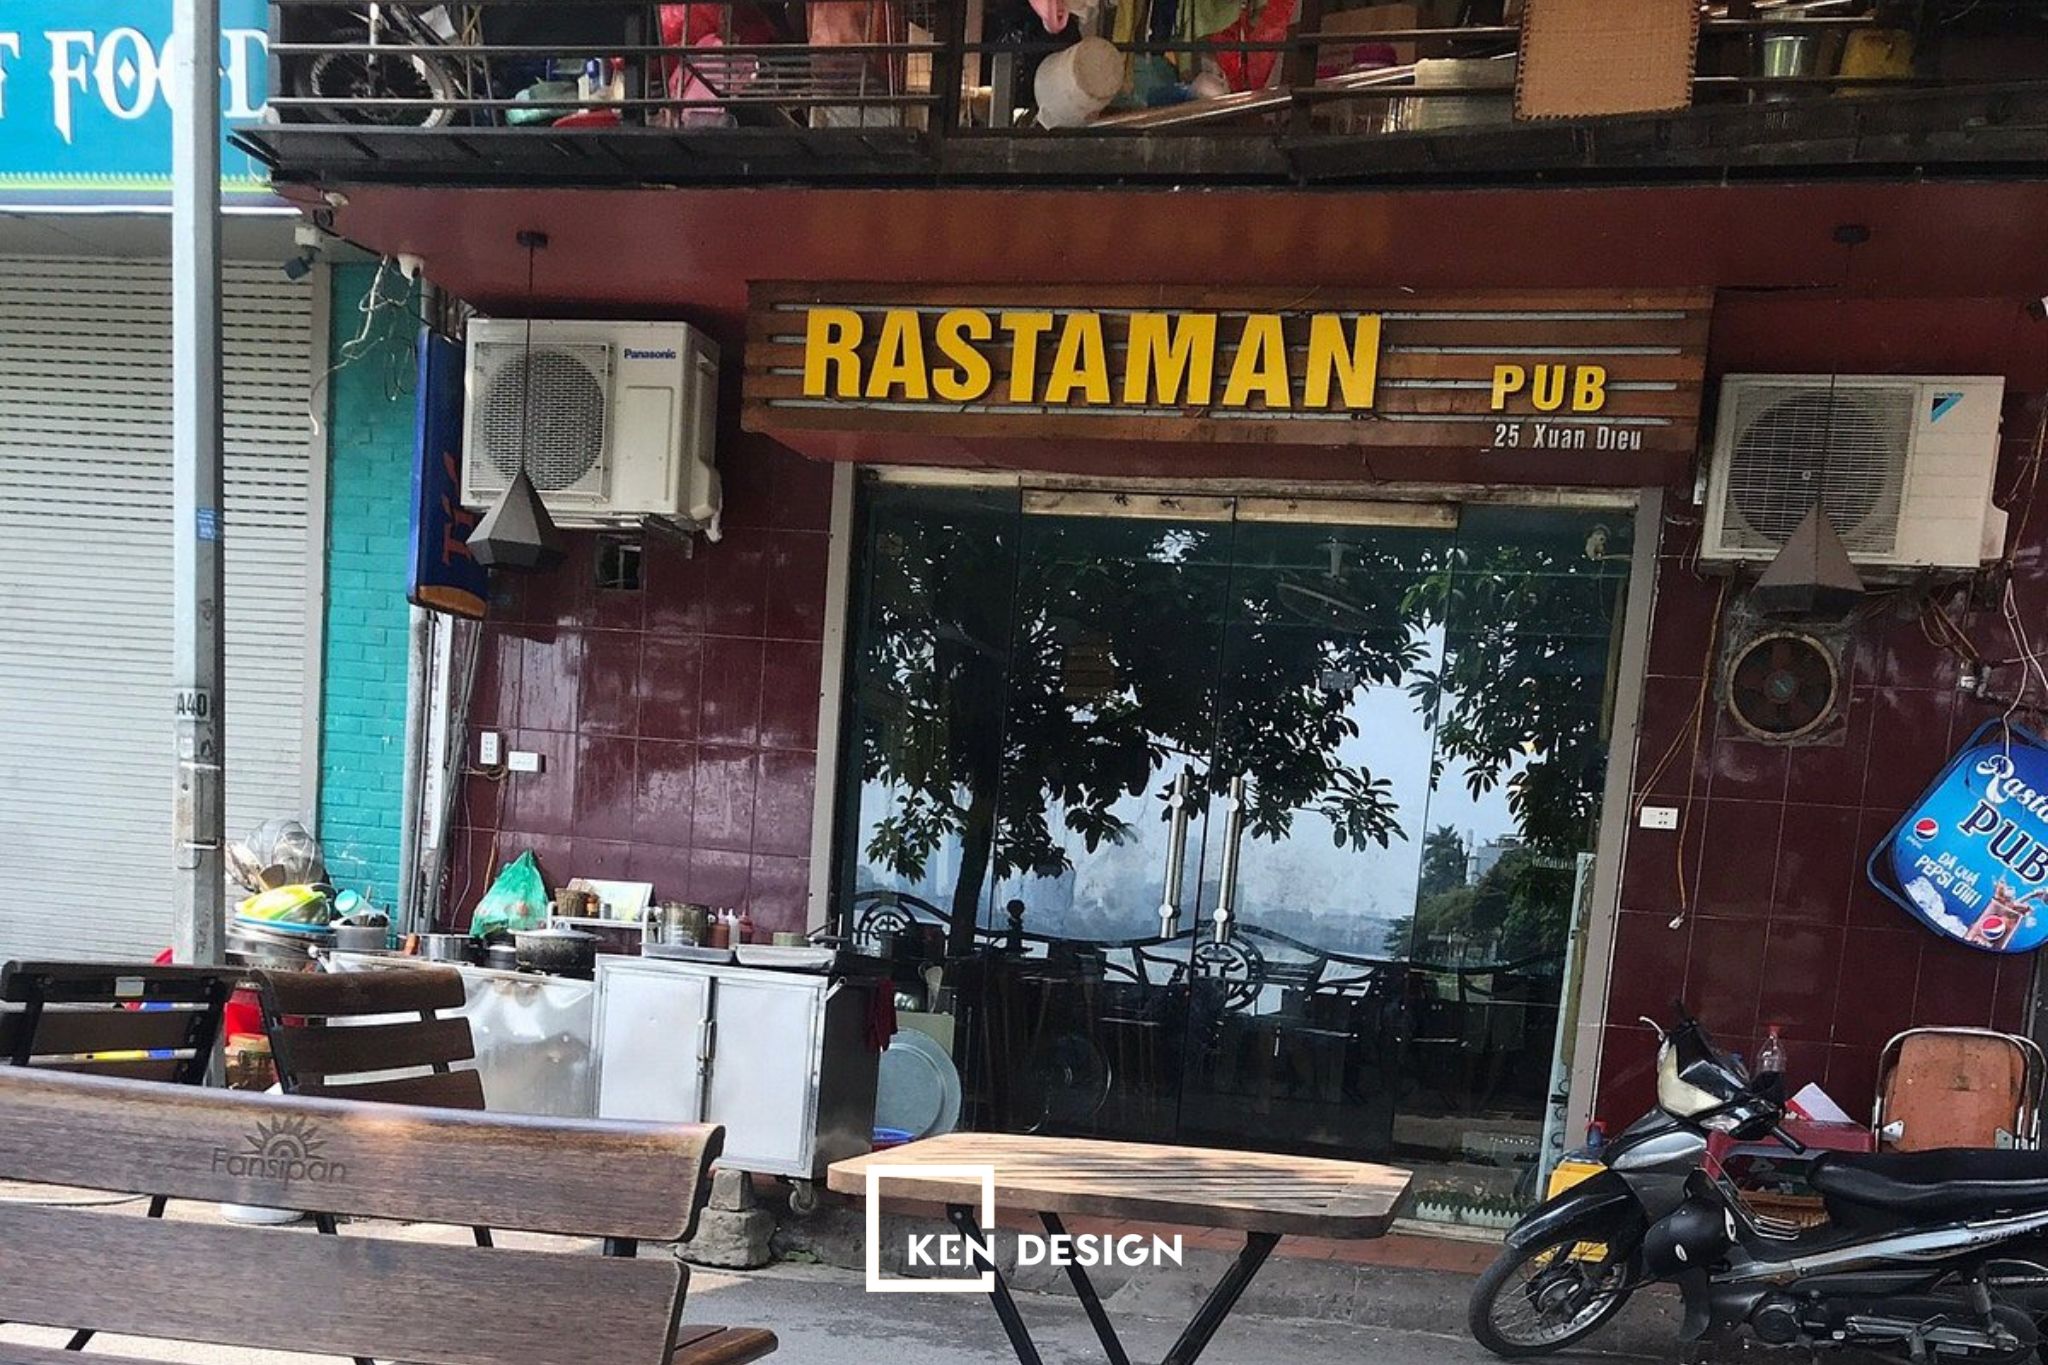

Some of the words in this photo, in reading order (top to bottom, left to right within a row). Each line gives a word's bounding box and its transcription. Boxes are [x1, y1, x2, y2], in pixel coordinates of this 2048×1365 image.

[43, 27, 269, 145] FOD
[624, 348, 677, 359] Panasonic
[803, 307, 1382, 409] RASTAMAN
[1491, 364, 1607, 412] PUB
[1494, 423, 1520, 448] 25
[1532, 423, 1586, 449] Xuan
[1596, 426, 1642, 450] Dieu
[176, 692, 208, 717] A40
[1957, 799, 2048, 884] PUB
[1914, 854, 1955, 889] PEPSI
[211, 1147, 347, 1191] Fansipan
